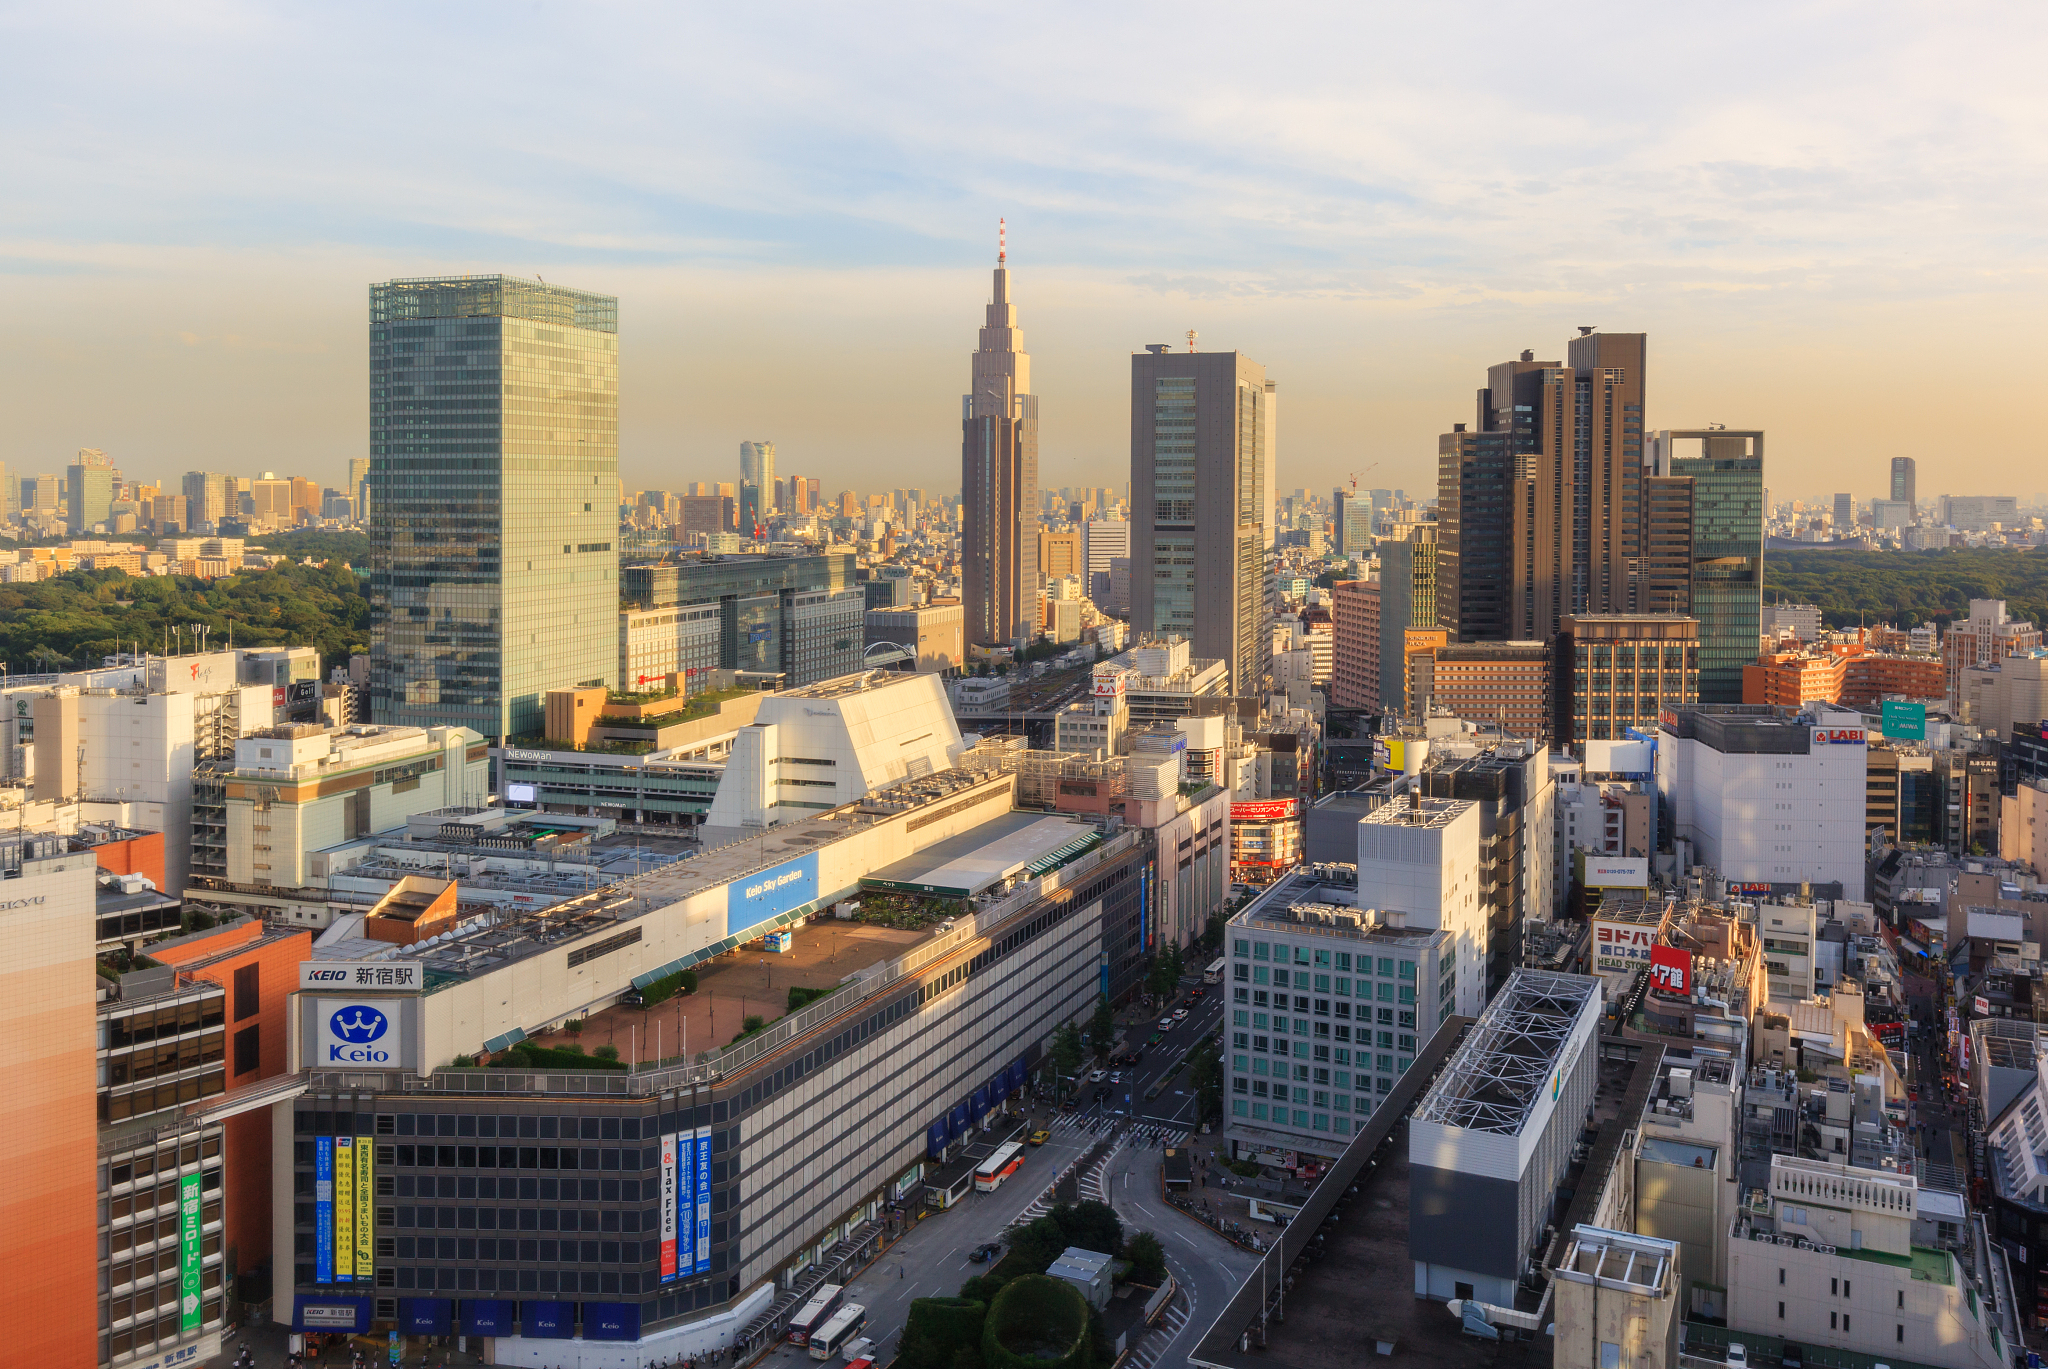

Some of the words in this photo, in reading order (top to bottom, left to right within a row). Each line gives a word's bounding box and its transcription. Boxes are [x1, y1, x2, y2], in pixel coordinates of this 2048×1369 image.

[300, 688, 314, 696] Golf
[1096, 684, 1116, 693] 丸八
[1829, 730, 1864, 739] LABI
[508, 750, 552, 760] NEWoMan
[746, 884, 762, 899] Keio
[763, 879, 777, 892] Sky
[777, 869, 802, 886] Garden
[1742, 883, 1771, 891] LABI
[1598, 927, 1656, 946] ヨドバ
[1597, 957, 1622, 968] HEAD
[308, 970, 347, 981] KEIO
[356, 967, 413, 985] 新宿駅
[329, 1044, 389, 1062] Keio
[665, 1166, 673, 1194] Tax
[183, 1182, 199, 1267] 新宿ミロード
[330, 1309, 353, 1317] 新宿駅
[415, 1317, 433, 1325] Keio
[477, 1318, 494, 1327] Keio
[538, 1320, 556, 1328] Keio
[164, 1345, 197, 1364] 新宿駅
